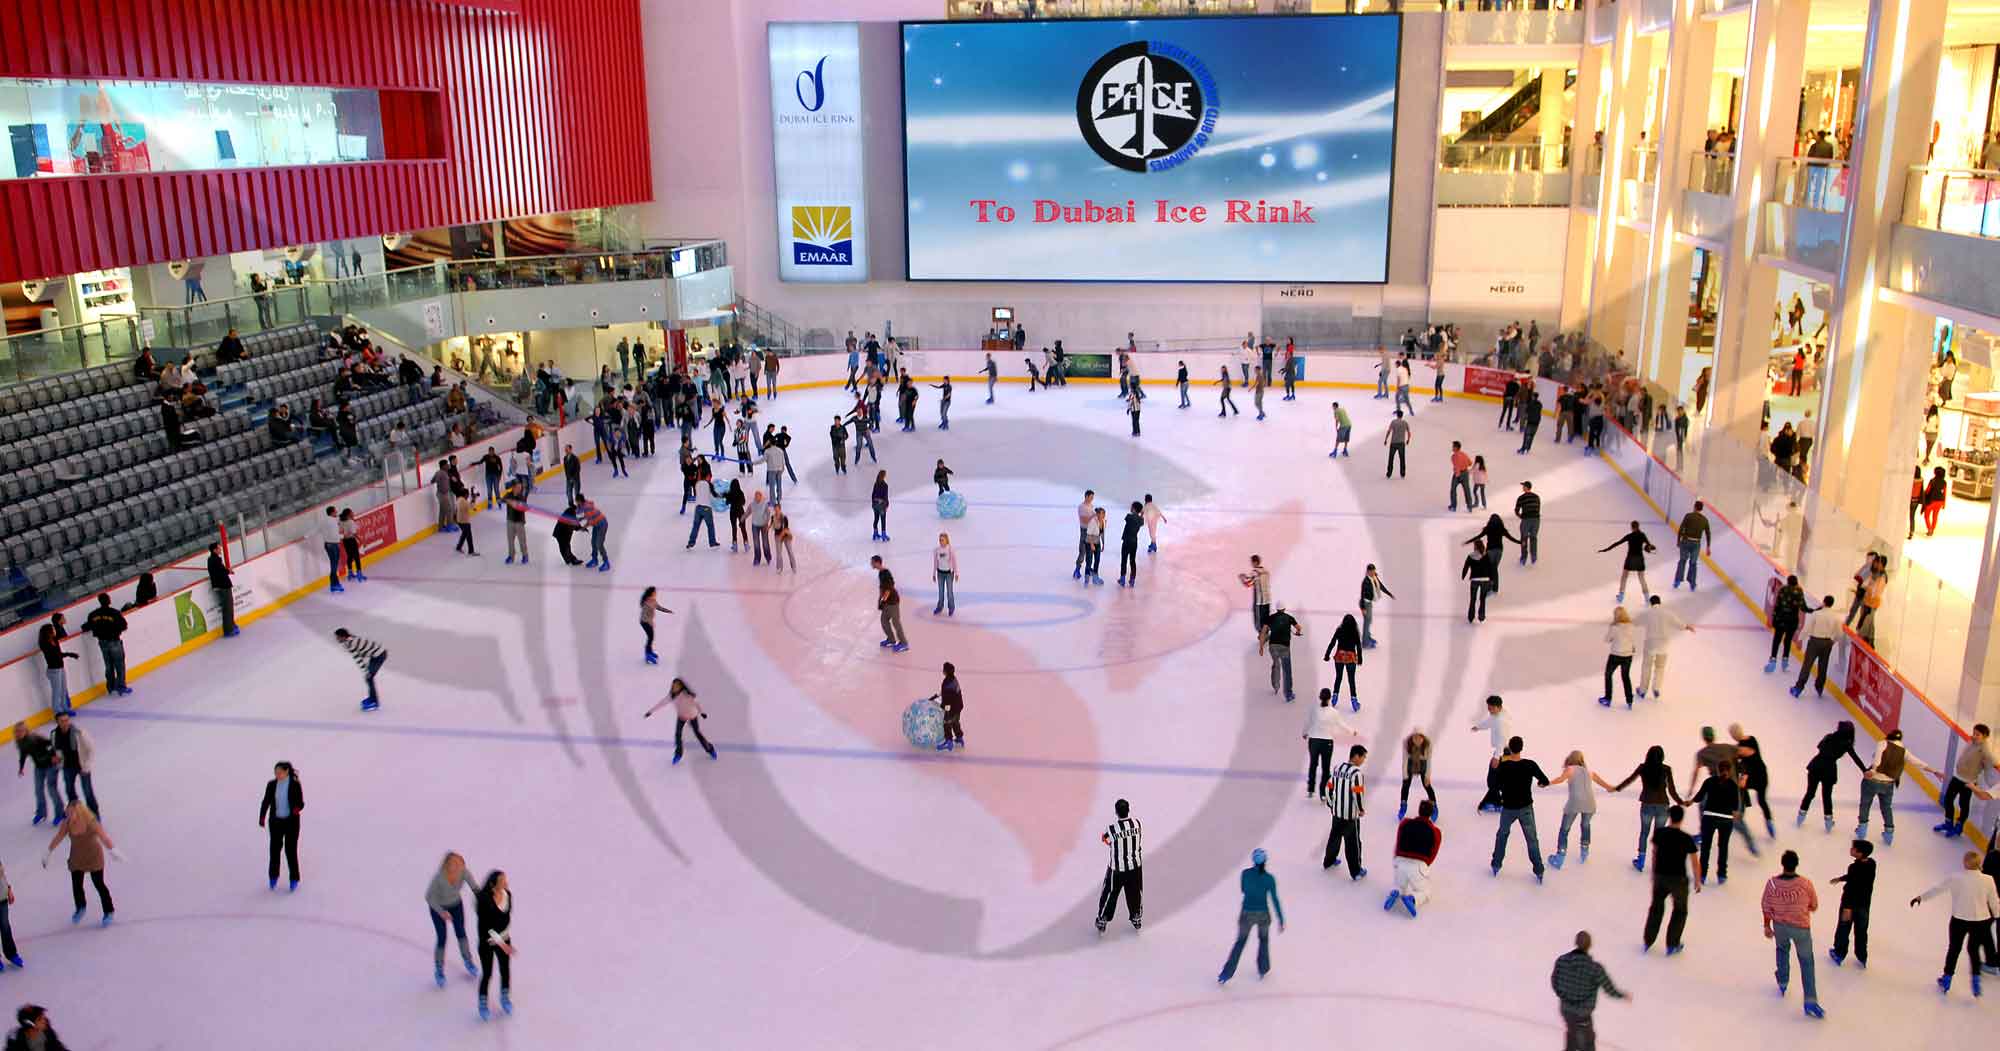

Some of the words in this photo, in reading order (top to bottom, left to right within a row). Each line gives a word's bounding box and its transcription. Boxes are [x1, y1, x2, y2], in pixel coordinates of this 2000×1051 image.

[1102, 82, 1192, 110] FACE
[779, 115, 809, 124] DUBAI
[813, 115, 829, 124] ICE
[832, 115, 855, 124] RINK
[970, 199, 1016, 223] To
[1031, 199, 1137, 223] Dubai
[1153, 199, 1208, 223] Ice
[1224, 199, 1315, 223] Rink
[800, 252, 848, 262] EMAAR
[1280, 289, 1314, 297] NERO
